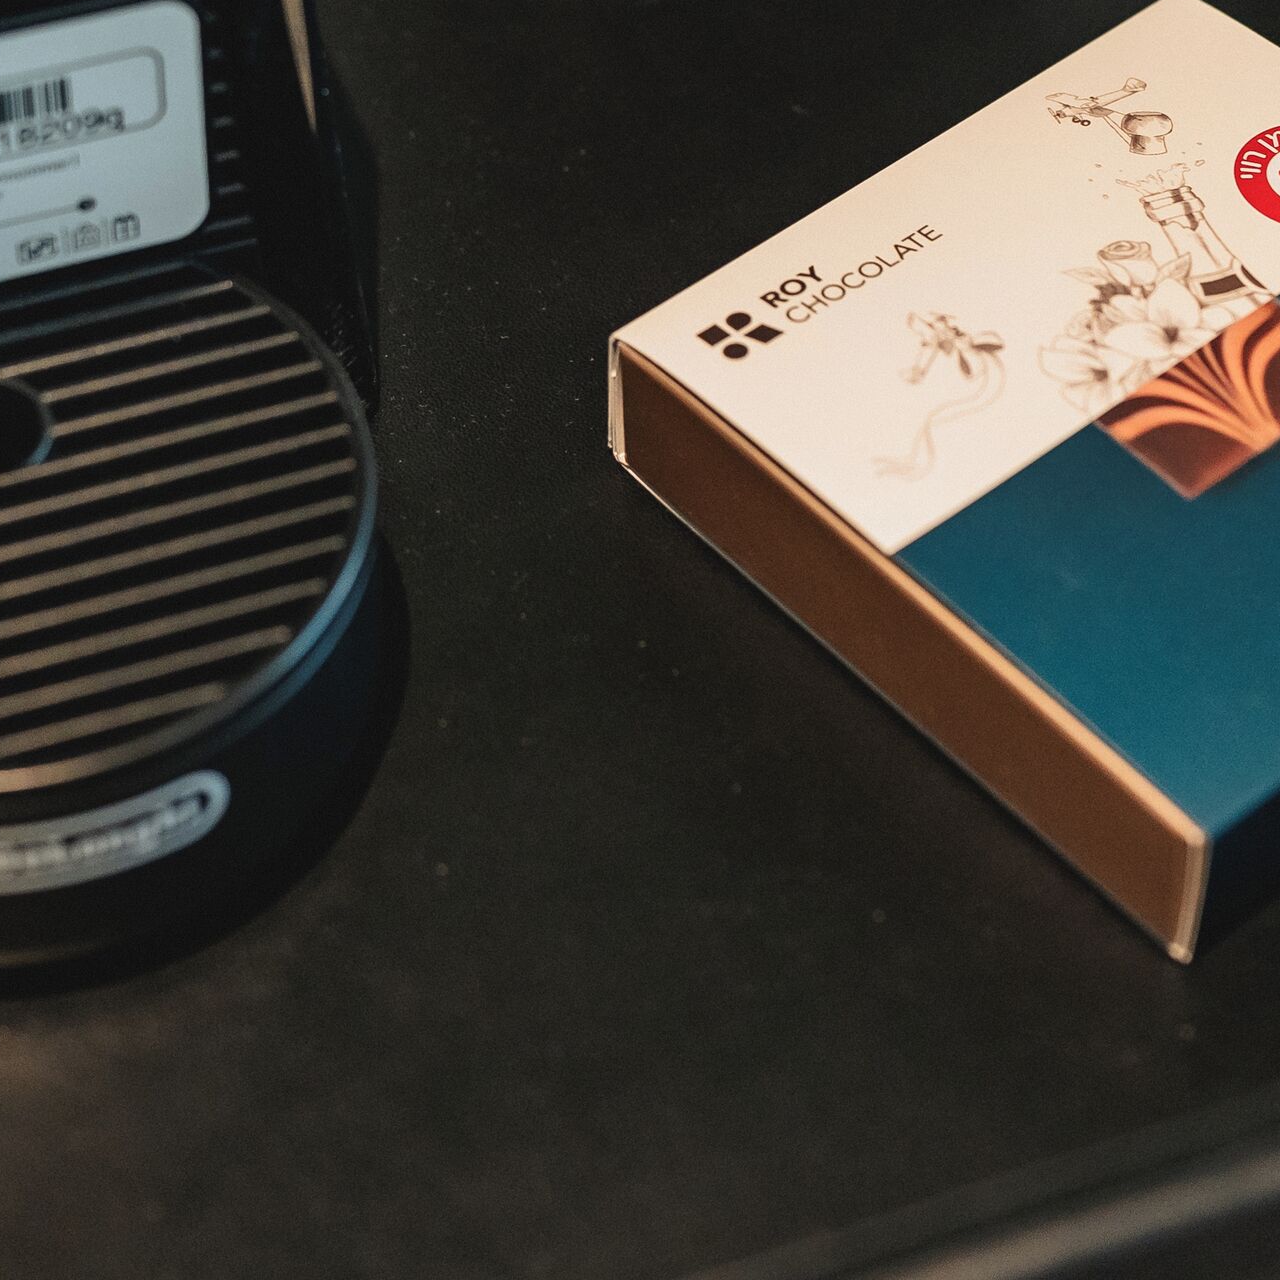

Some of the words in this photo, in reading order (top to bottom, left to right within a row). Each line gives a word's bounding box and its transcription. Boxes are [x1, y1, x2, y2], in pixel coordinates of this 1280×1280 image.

[1239, 150, 1267, 180] רווי
[759, 265, 824, 308] ROY
[785, 224, 944, 324] CHOCOLATE
